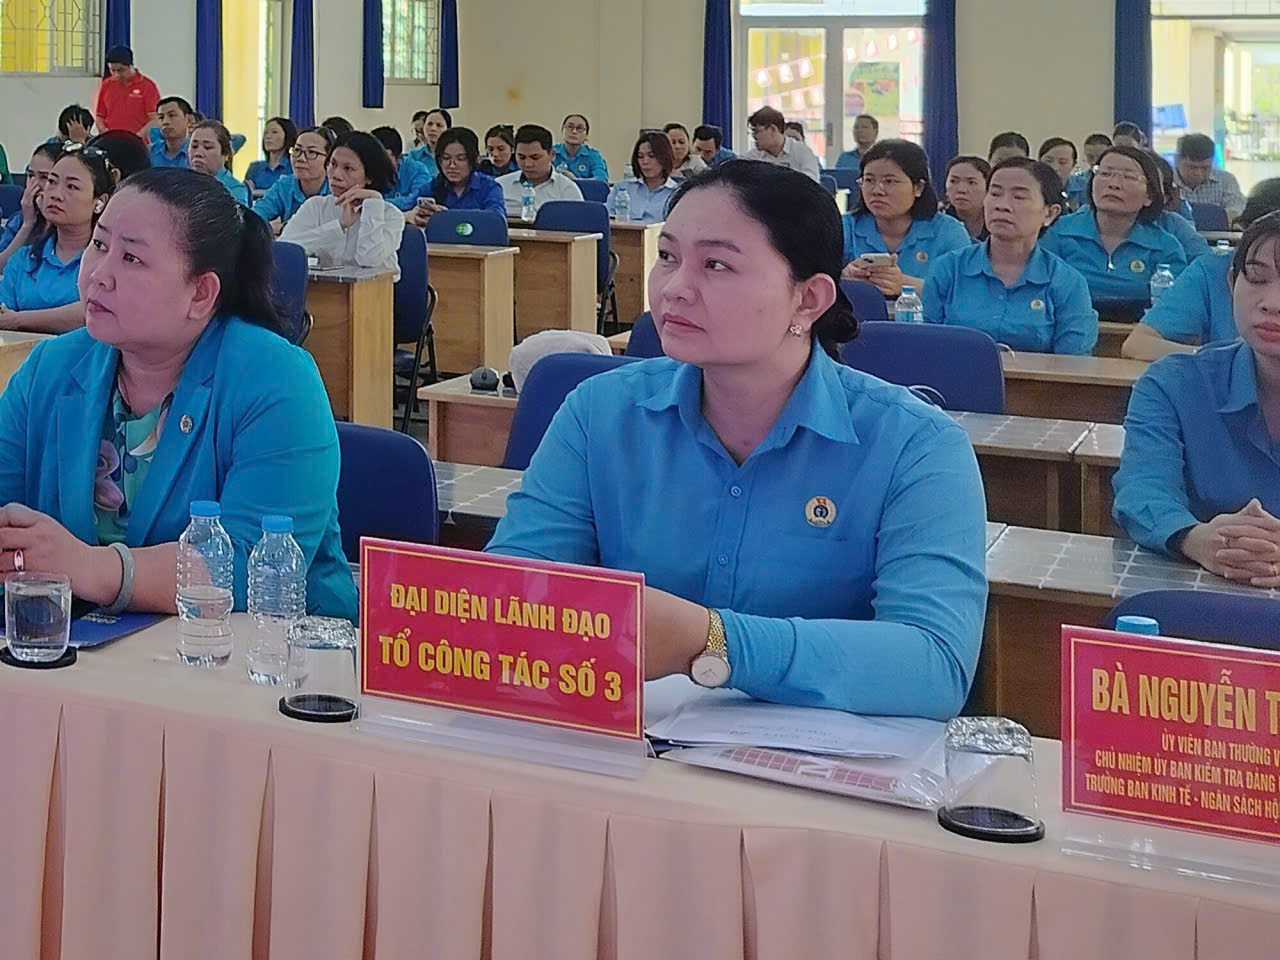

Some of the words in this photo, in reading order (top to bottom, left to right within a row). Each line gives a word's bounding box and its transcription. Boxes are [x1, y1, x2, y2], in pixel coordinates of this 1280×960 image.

[390, 583, 427, 616] ĐẠI
[434, 589, 487, 623] DIỆN
[494, 596, 555, 631] LÃNH
[562, 607, 610, 642] ĐẠO
[379, 628, 412, 667] TỔ
[418, 639, 490, 681] CÔNG
[498, 651, 550, 689] TÁC
[558, 657, 597, 697] SỐ
[604, 671, 622, 701] 3
[1092, 661, 1130, 715] BÀ
[1138, 669, 1256, 732] NGUYỄN
[1118, 752, 1152, 776] NHIỆM
[1170, 760, 1192, 780] BAN
[1194, 759, 1221, 784] KIỂM
[1224, 768, 1243, 788] TRA
[1246, 767, 1276, 792] ĐẢNG
[1178, 734, 1201, 756] VIÊN
[1204, 739, 1226, 759] BAN
[1229, 742, 1271, 766] THƯỜNG
[1127, 779, 1149, 799] BAN
[1151, 783, 1176, 804] KINH
[1179, 784, 1191, 806] TẾ
[1201, 789, 1231, 812] NGÂN
[1233, 793, 1262, 817] SÁCH
